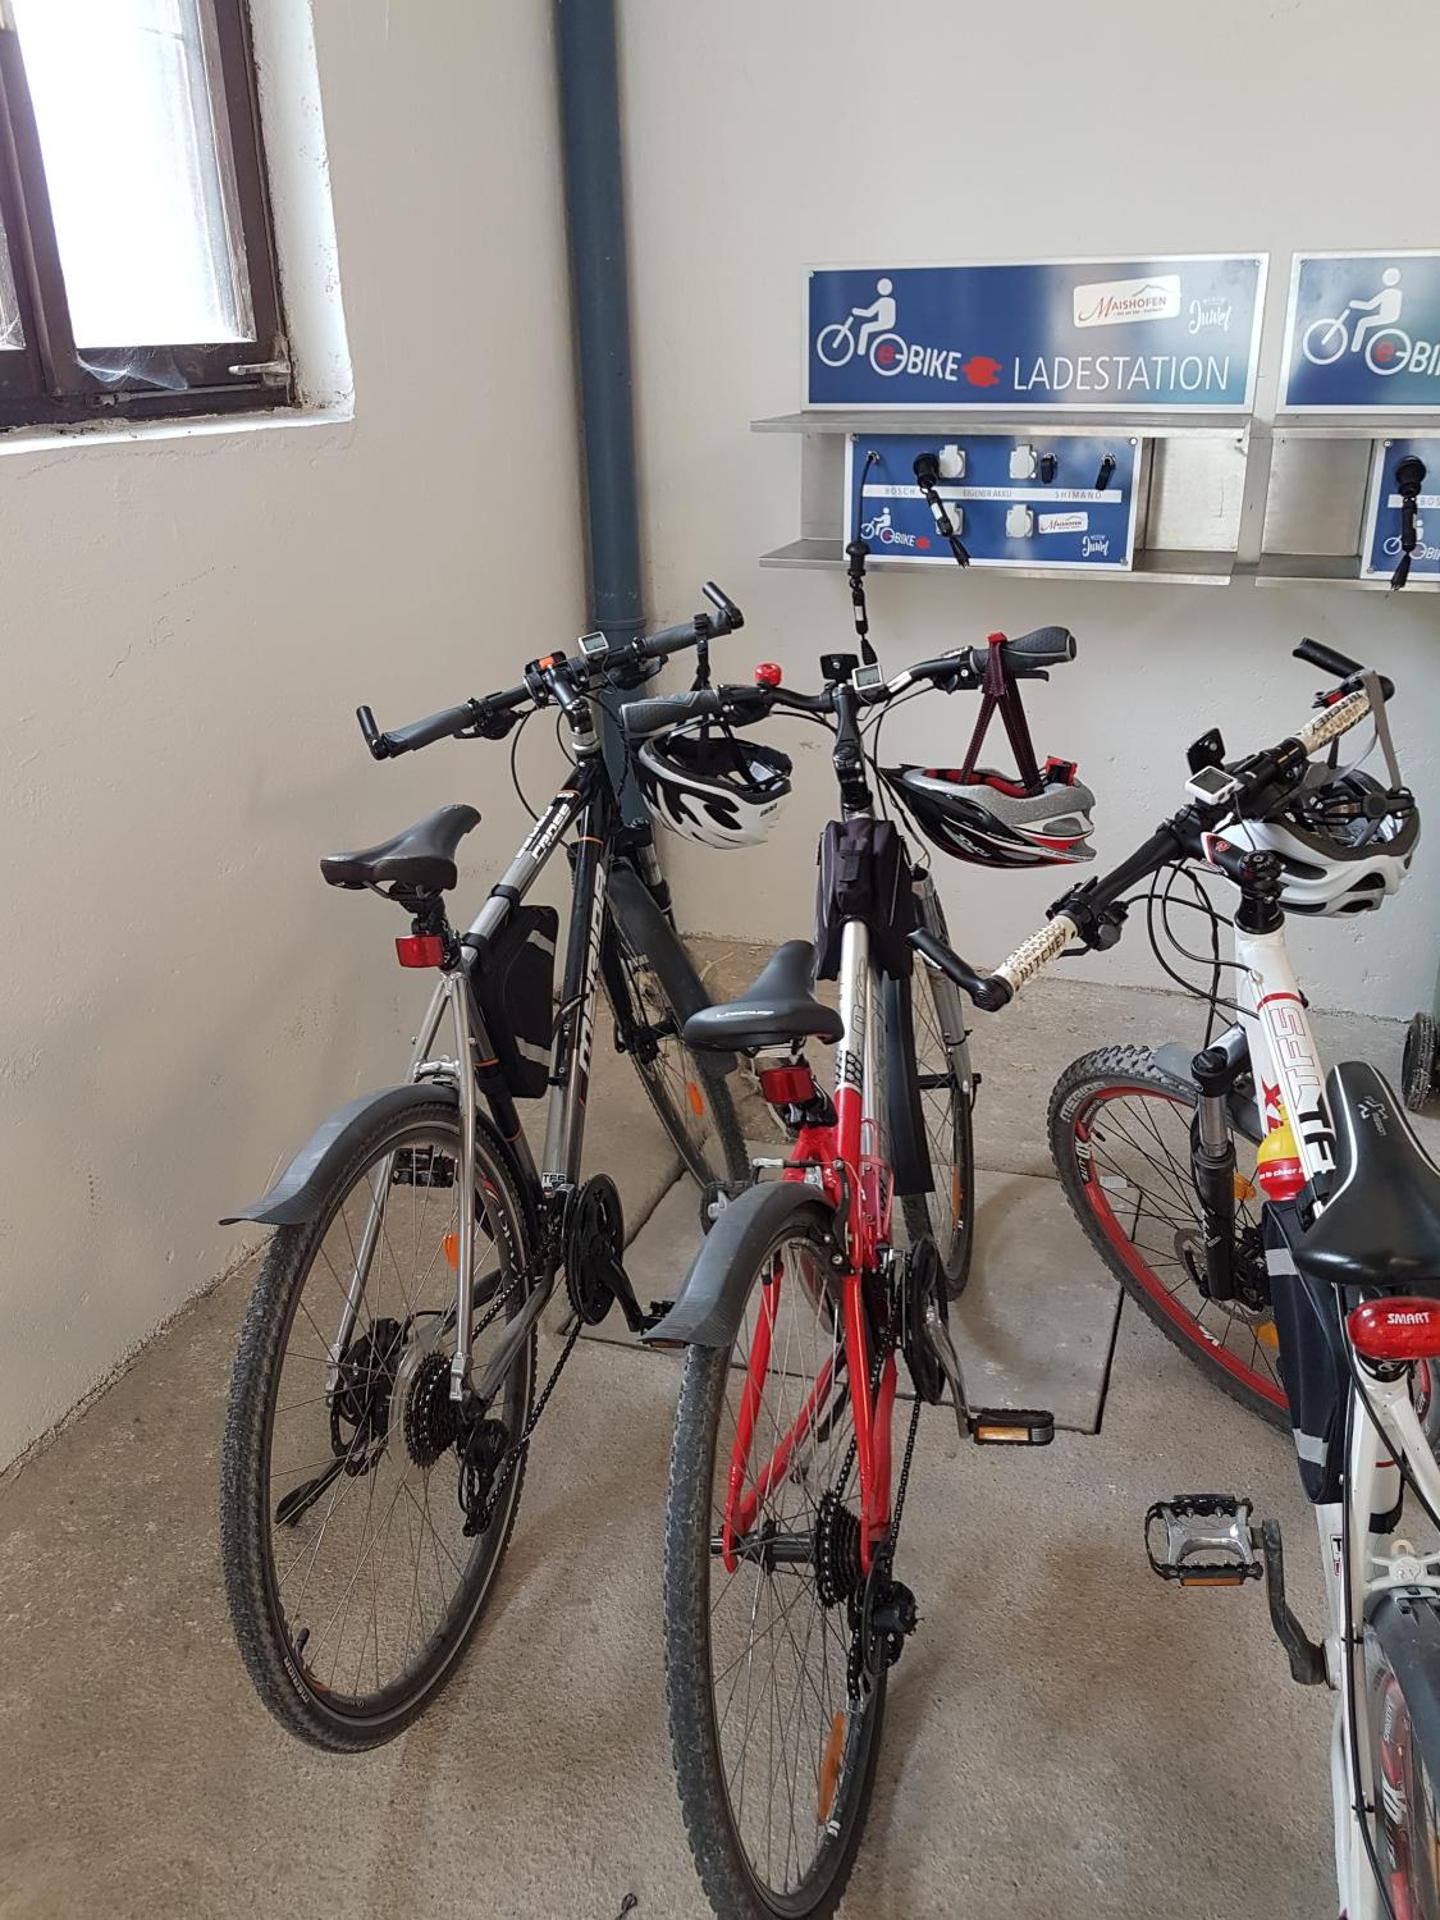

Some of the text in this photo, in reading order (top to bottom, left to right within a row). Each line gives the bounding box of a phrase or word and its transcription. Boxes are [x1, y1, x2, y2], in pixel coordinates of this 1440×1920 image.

[1078, 296, 1167, 321] MAISHOFEN
[1013, 355, 1230, 391] LADESTATION
[1055, 490, 1102, 500] SHIMANO
[1387, 1311, 1430, 1325] SMART
